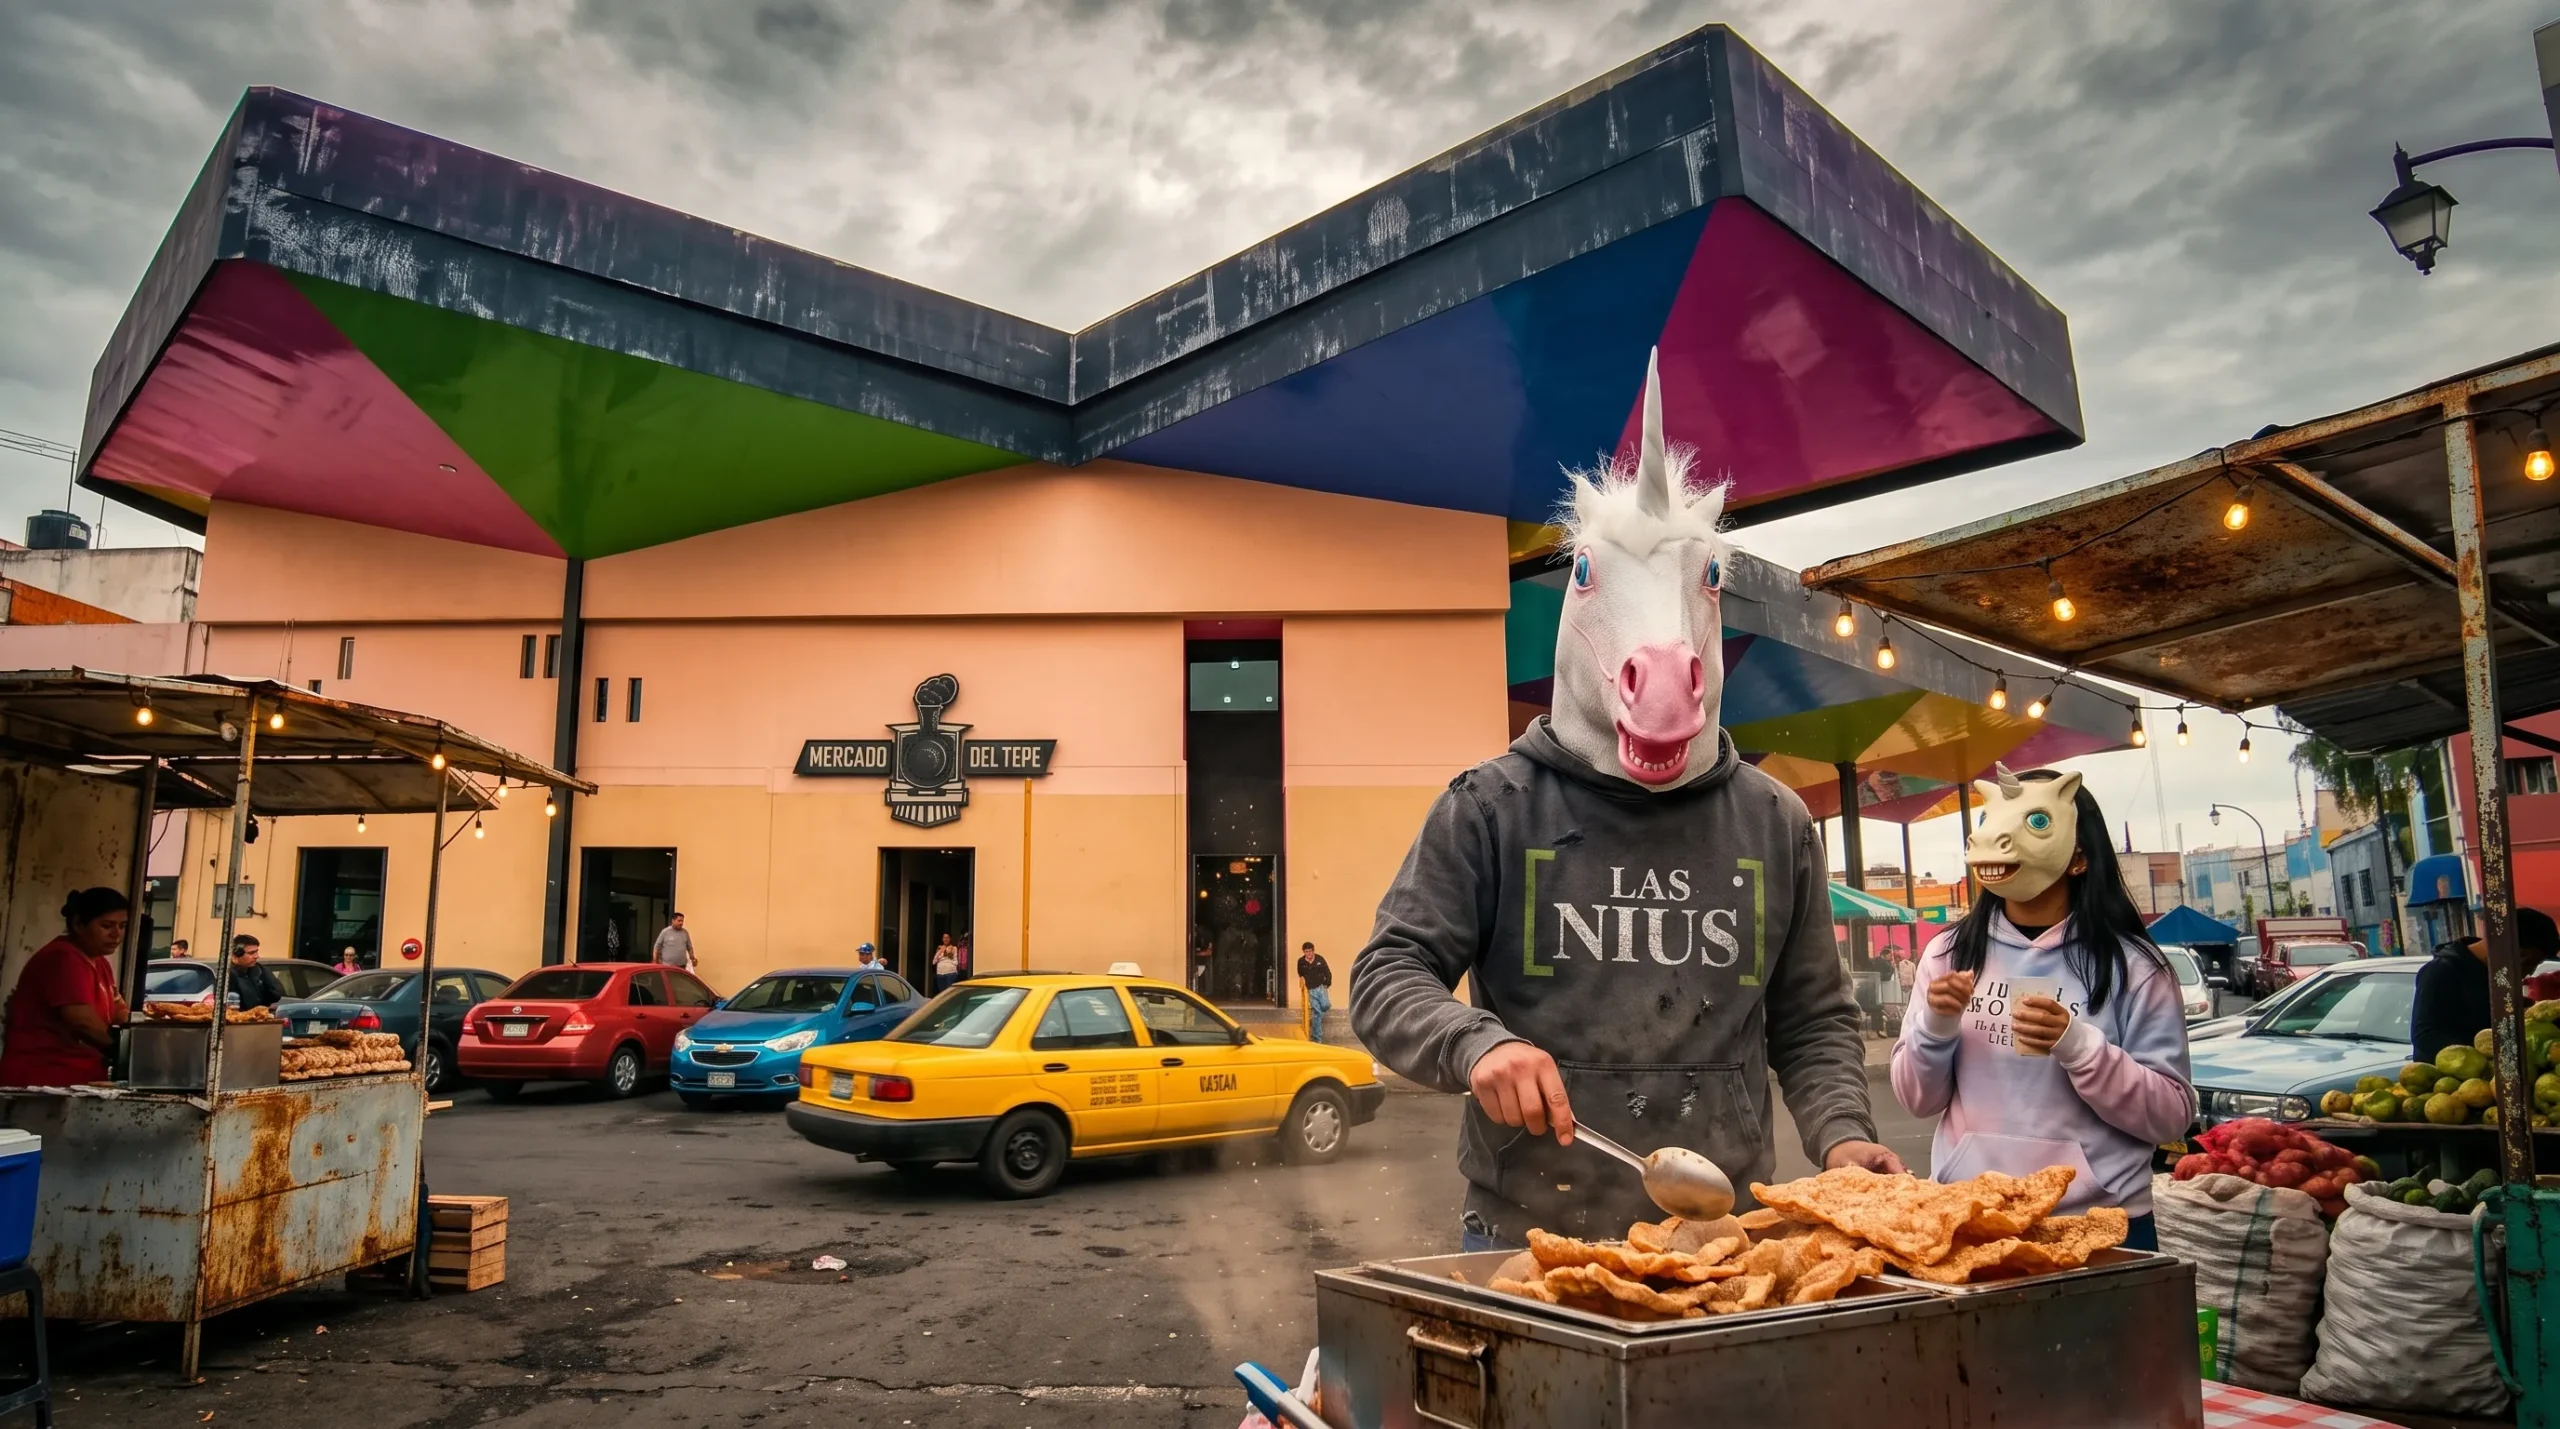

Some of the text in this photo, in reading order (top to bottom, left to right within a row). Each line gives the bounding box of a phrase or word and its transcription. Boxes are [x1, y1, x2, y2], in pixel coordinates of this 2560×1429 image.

[809, 746, 1041, 768] MERCADO DEL TEPE
[1609, 866, 1691, 902] LAS
[1552, 902, 1740, 968] NIUS
